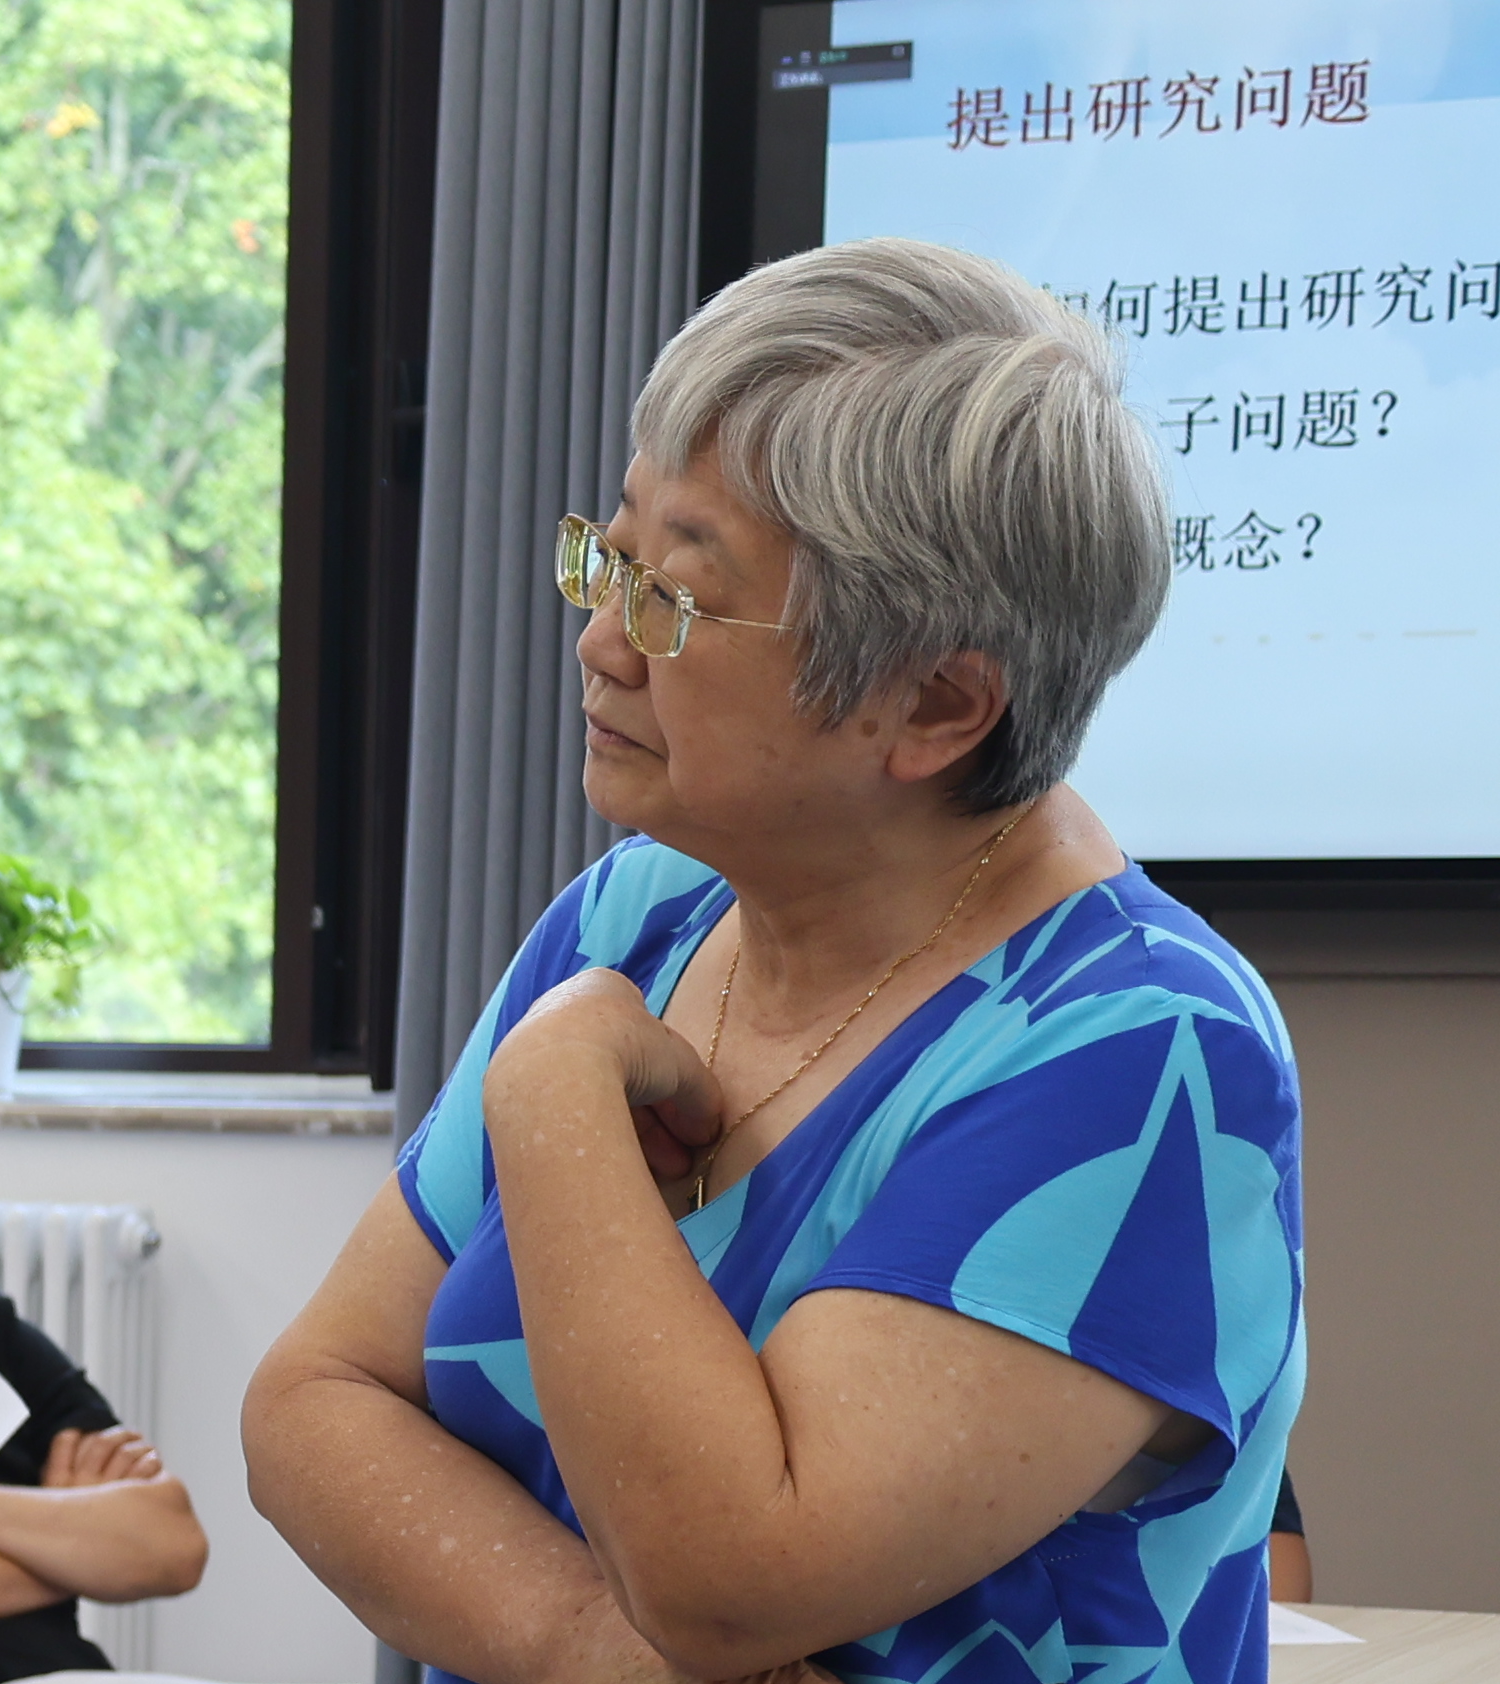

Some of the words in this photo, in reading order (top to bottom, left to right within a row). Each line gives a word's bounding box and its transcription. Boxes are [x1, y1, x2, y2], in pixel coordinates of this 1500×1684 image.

[946, 60, 1374, 151] 提出研究问题
